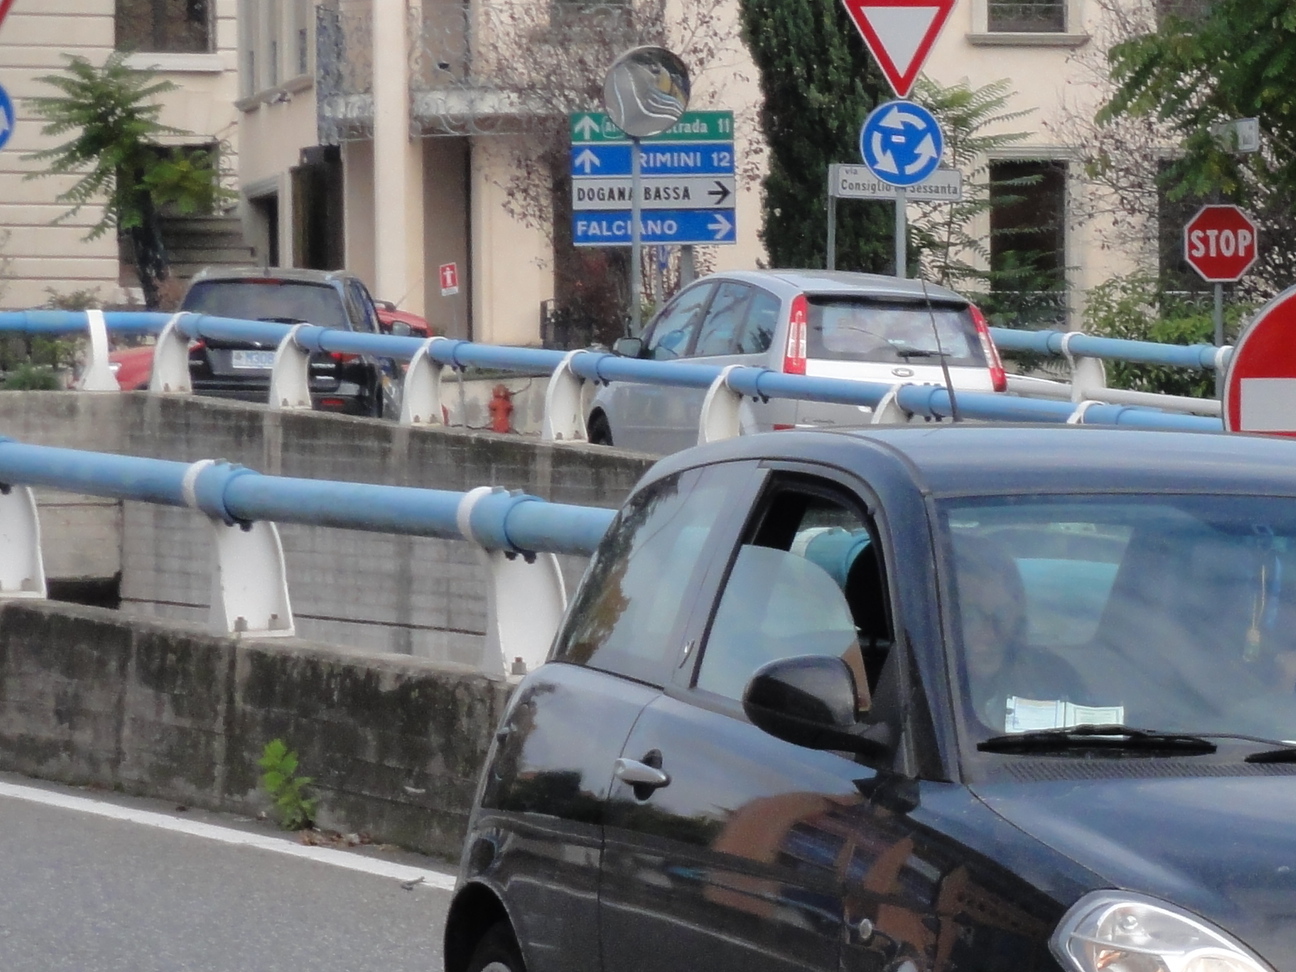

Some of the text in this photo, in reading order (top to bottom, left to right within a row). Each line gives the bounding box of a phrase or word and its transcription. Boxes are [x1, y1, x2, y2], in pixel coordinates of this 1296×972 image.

[717, 118, 730, 133] 11
[639, 151, 731, 168] RIMINI 12
[644, 186, 691, 201] BASSA
[841, 179, 891, 196] Consiglio
[1190, 229, 1252, 257] STOP
